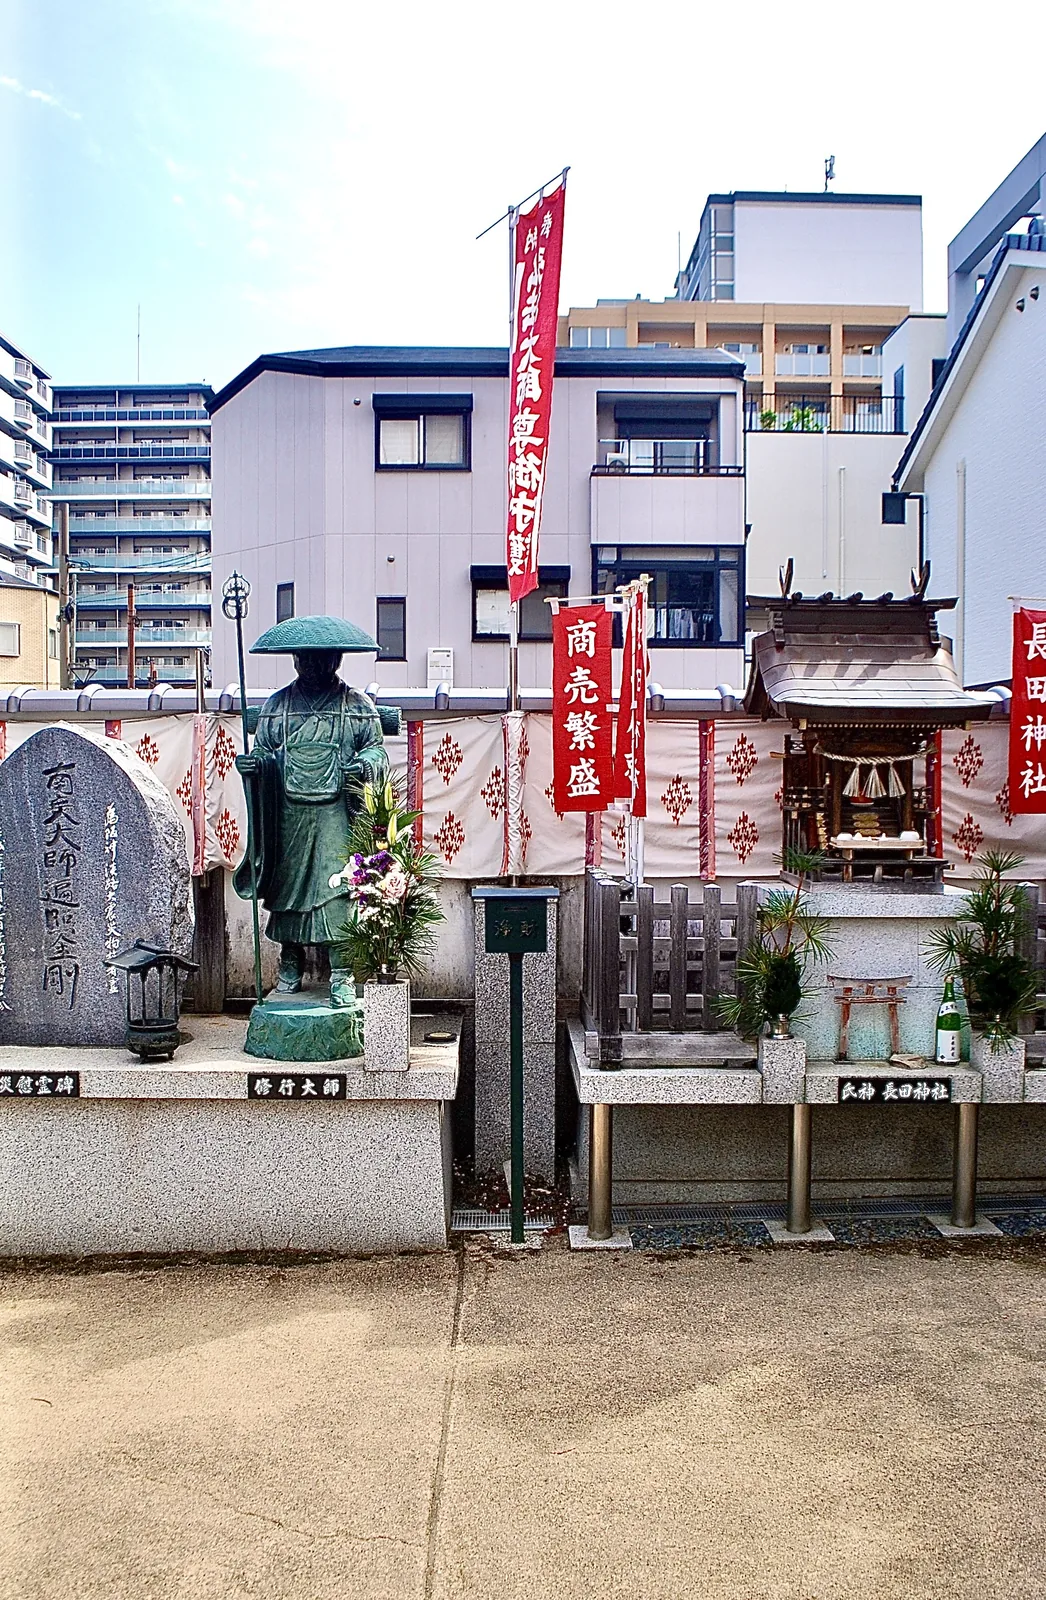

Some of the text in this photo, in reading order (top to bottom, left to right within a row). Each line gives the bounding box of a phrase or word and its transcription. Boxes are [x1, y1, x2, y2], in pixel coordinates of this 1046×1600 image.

[563, 619, 601, 799] 商売繁盛
[1018, 622, 1046, 799] 長田神社
[254, 1077, 340, 1097] 修行大師
[841, 1081, 949, 1101] 氏神 長田神社
